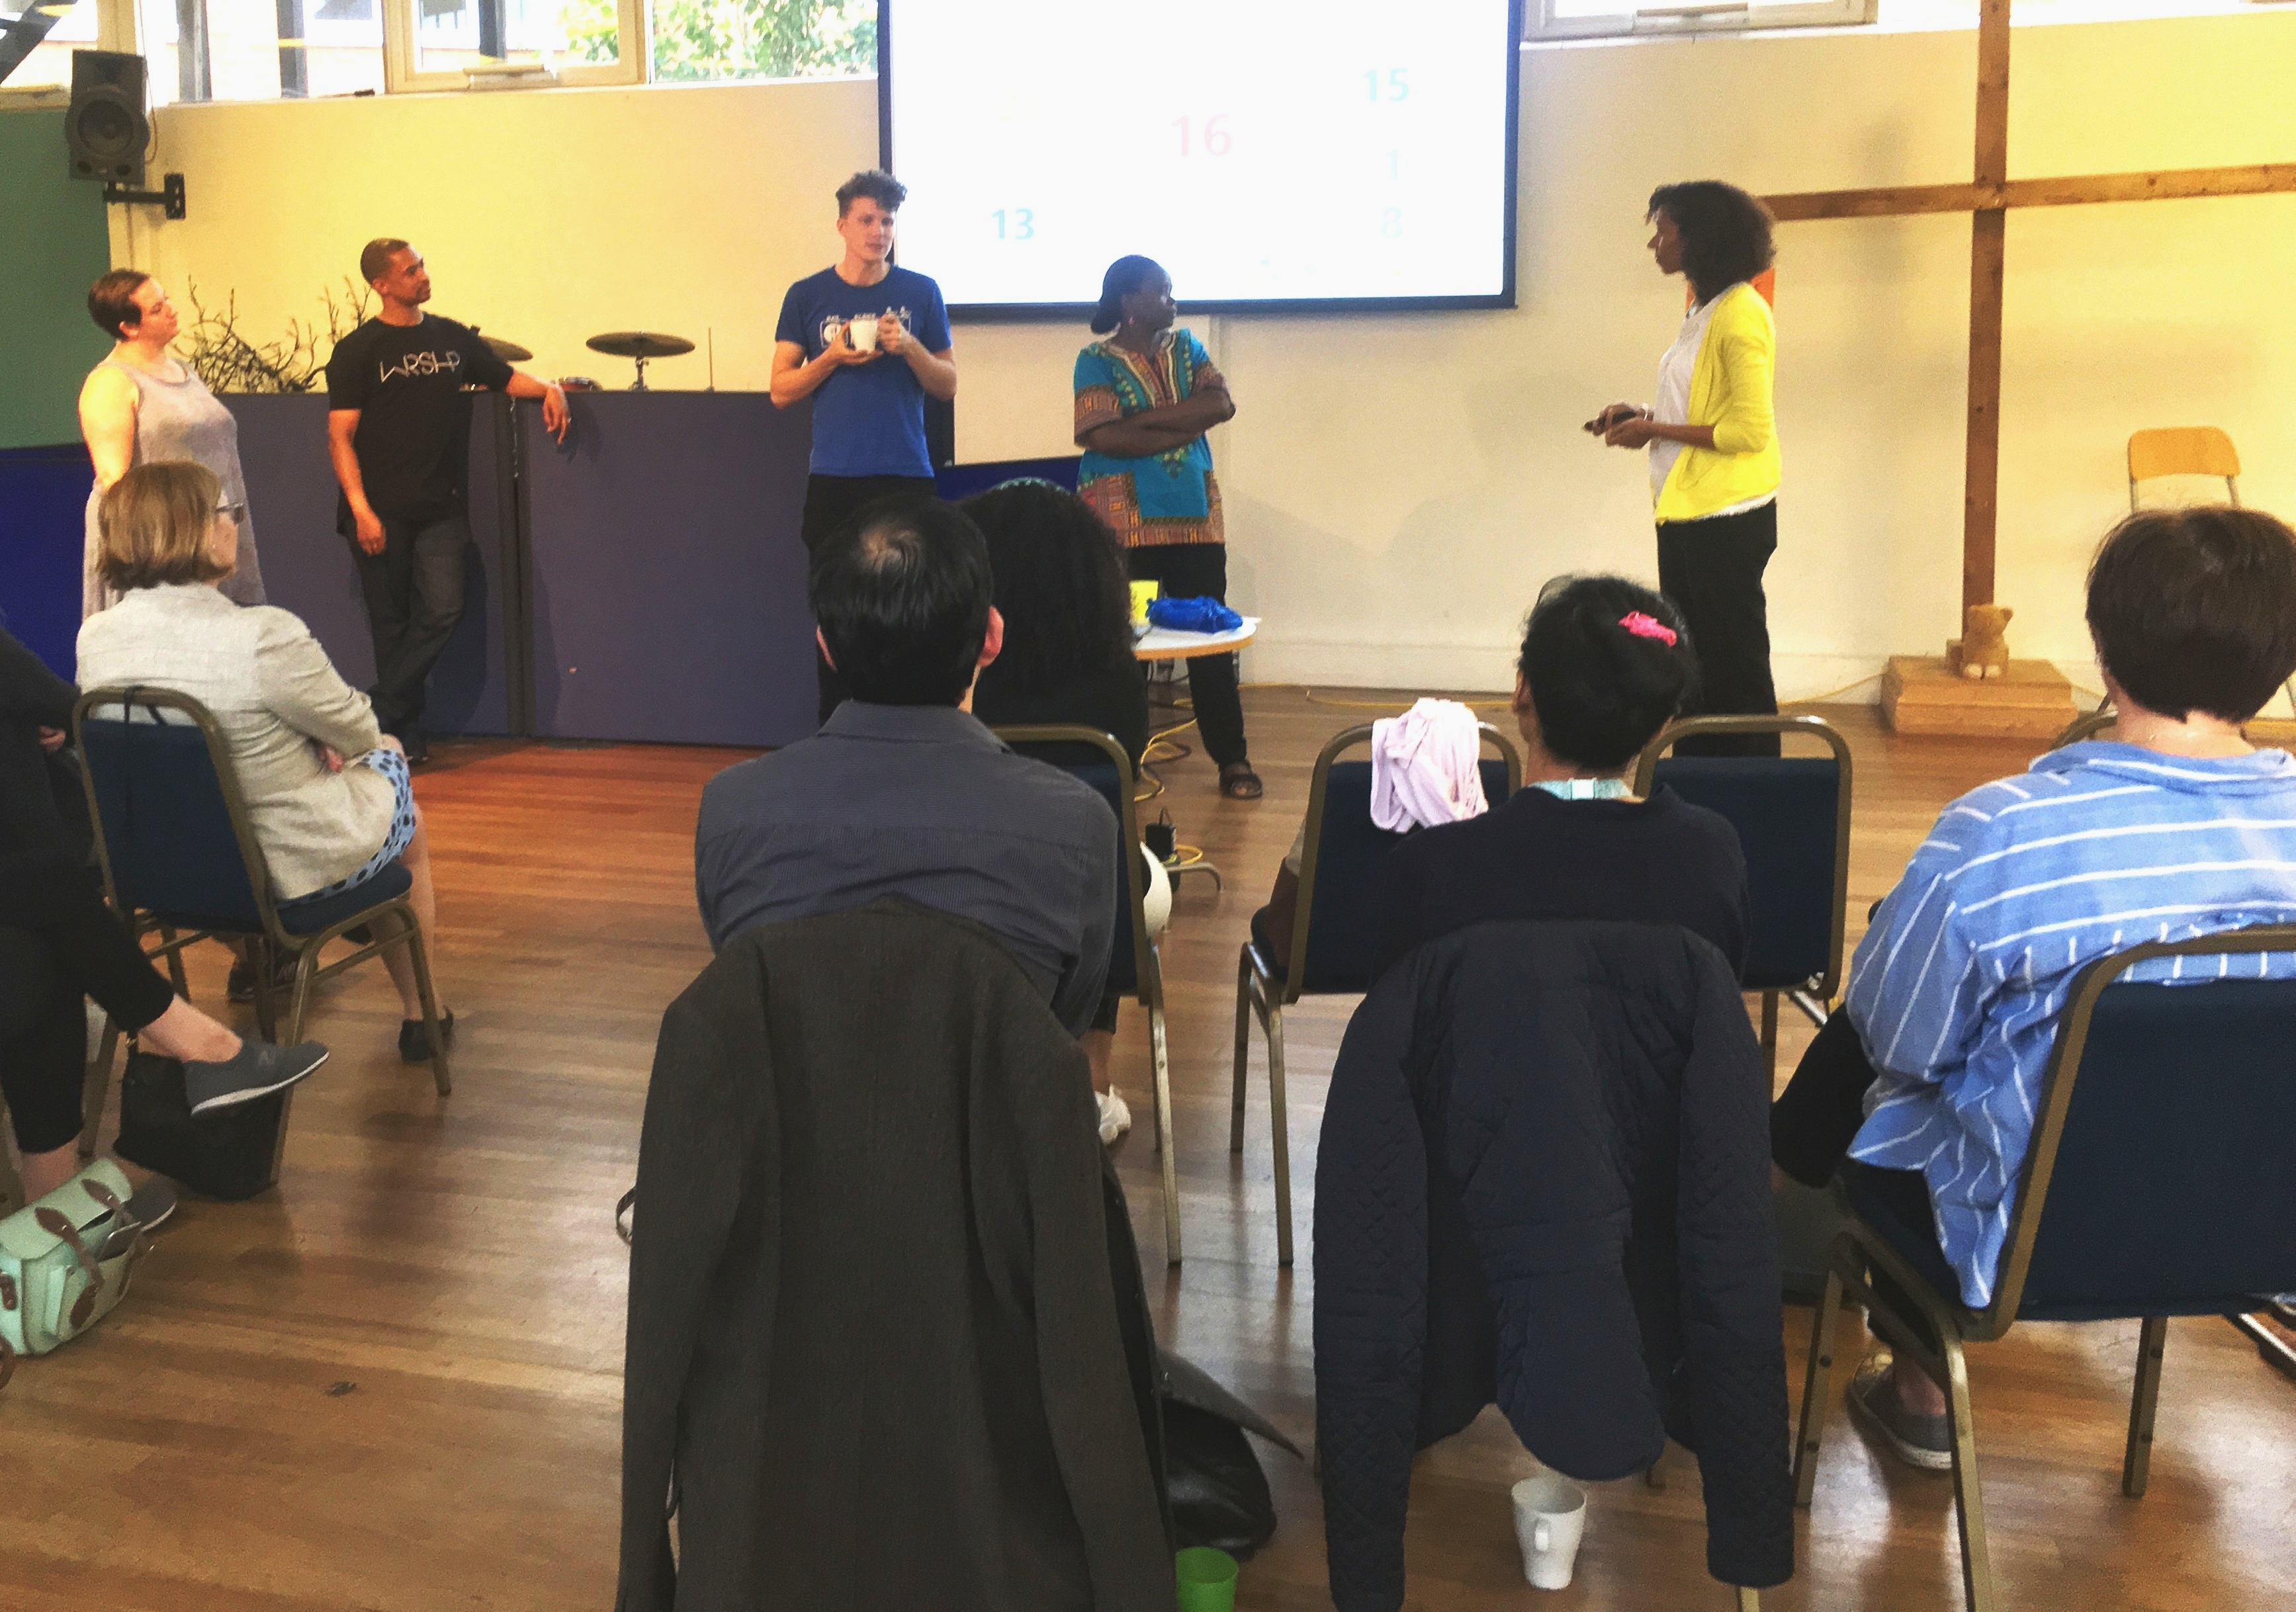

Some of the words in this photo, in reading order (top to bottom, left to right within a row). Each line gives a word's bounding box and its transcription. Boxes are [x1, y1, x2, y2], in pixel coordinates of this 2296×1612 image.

[1362, 66, 1411, 104] 15
[1172, 114, 1232, 157] 16
[991, 206, 1036, 241] 13
